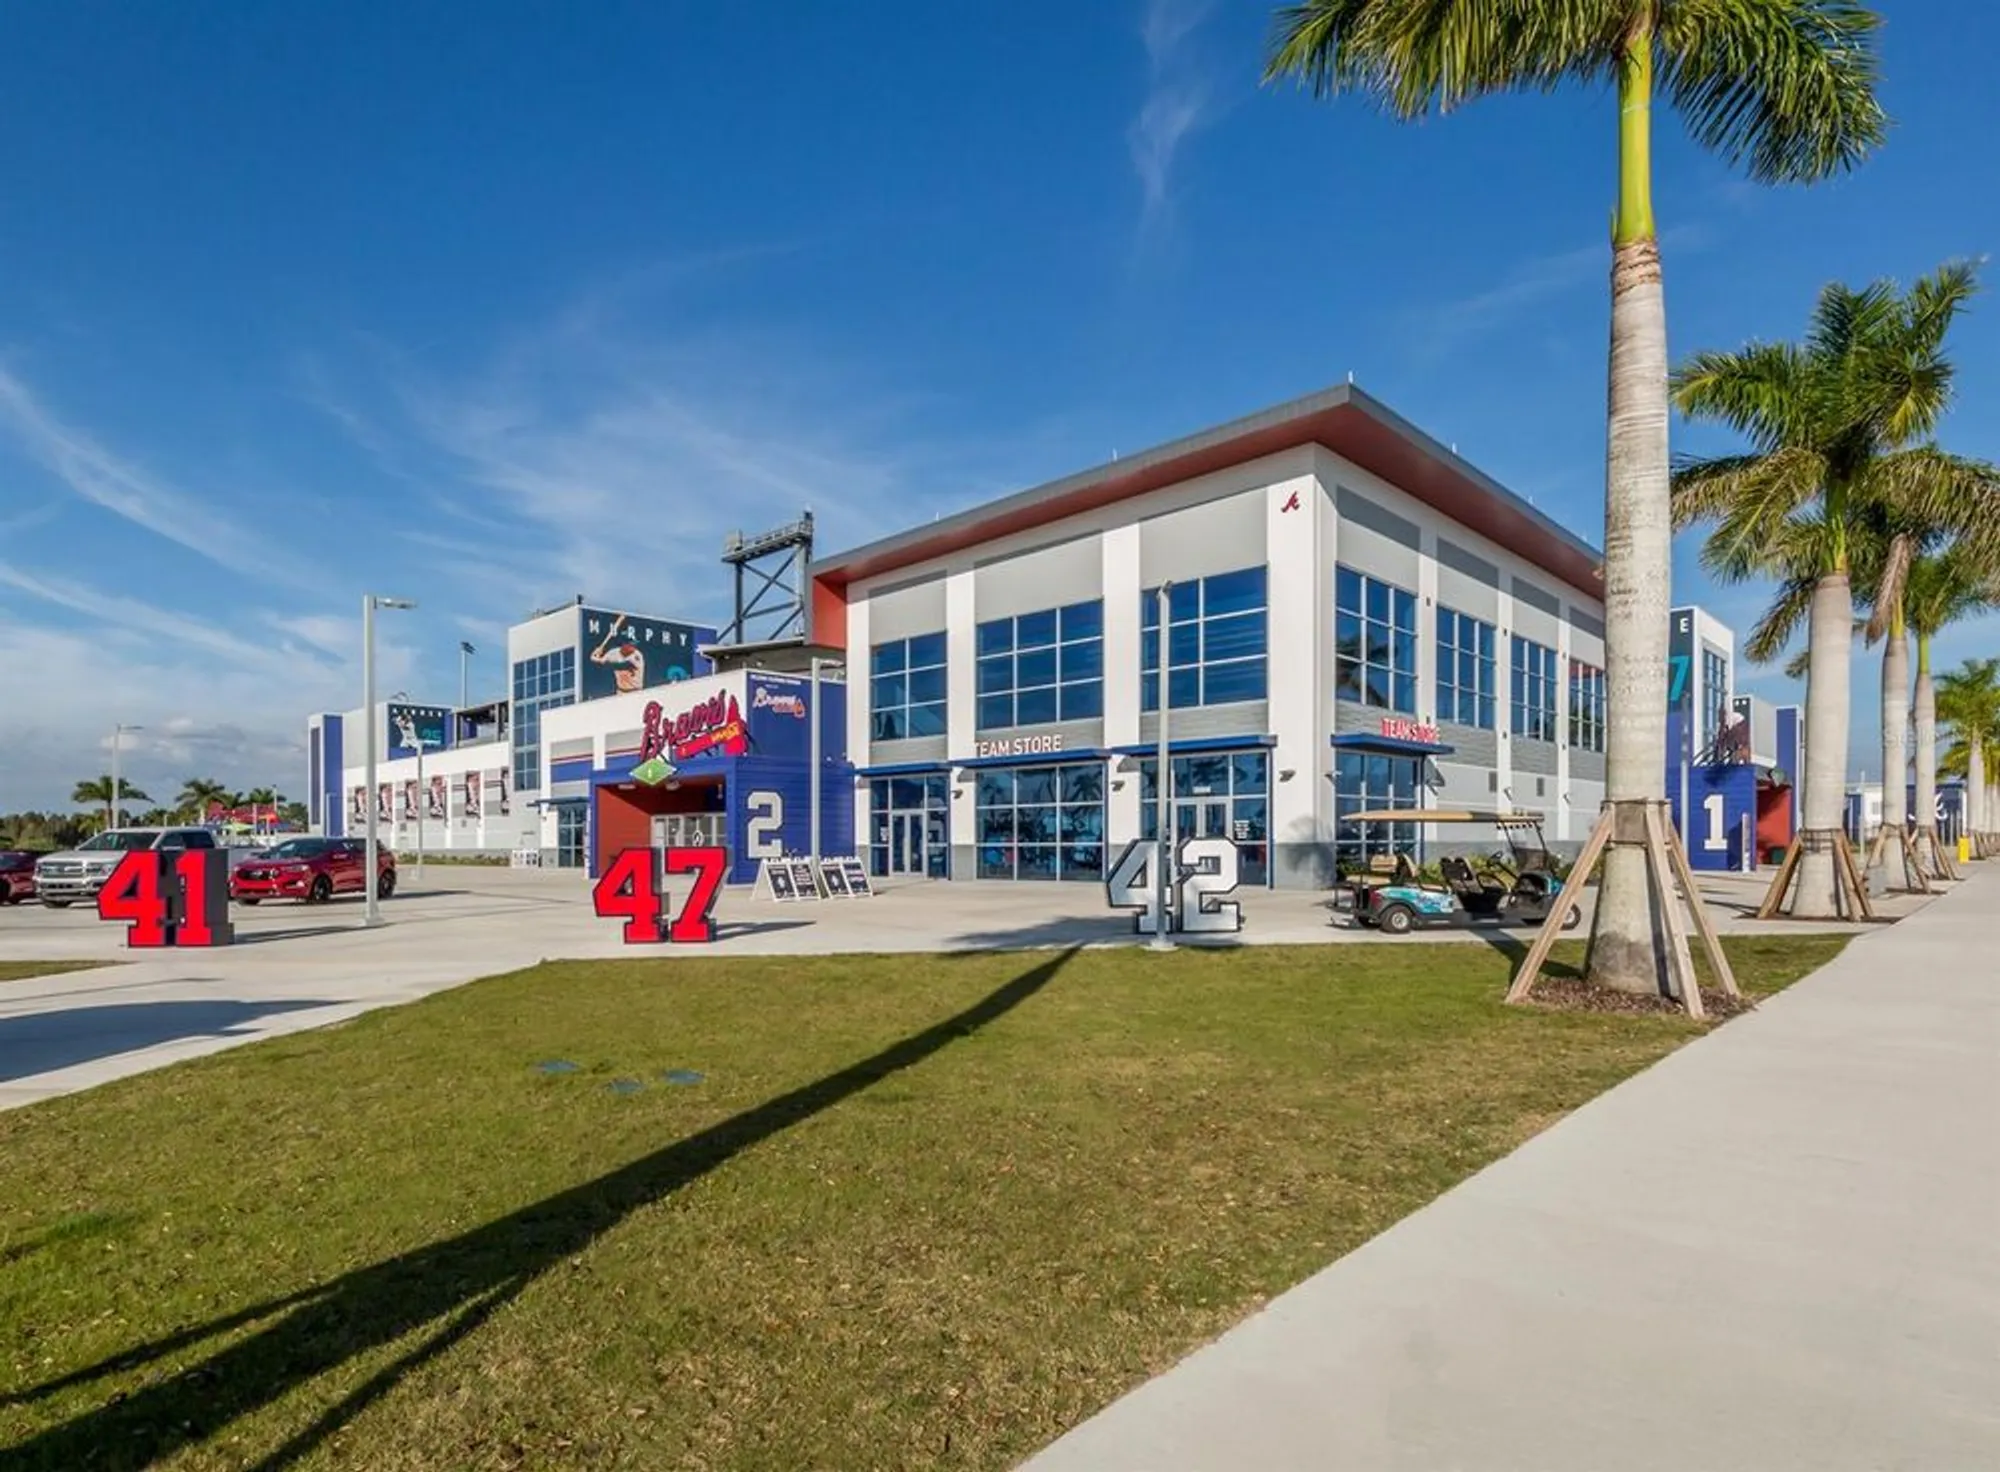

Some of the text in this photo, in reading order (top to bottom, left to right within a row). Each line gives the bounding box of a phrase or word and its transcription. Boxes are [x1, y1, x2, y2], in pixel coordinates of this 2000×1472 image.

[973, 734, 1063, 757] TEAM STORE
[1382, 718, 1411, 740] TEAM
[747, 791, 783, 859] 2
[1703, 793, 1728, 850] 1
[96, 849, 213, 948] 41
[592, 847, 727, 944] 47
[1107, 837, 1241, 935] 42
